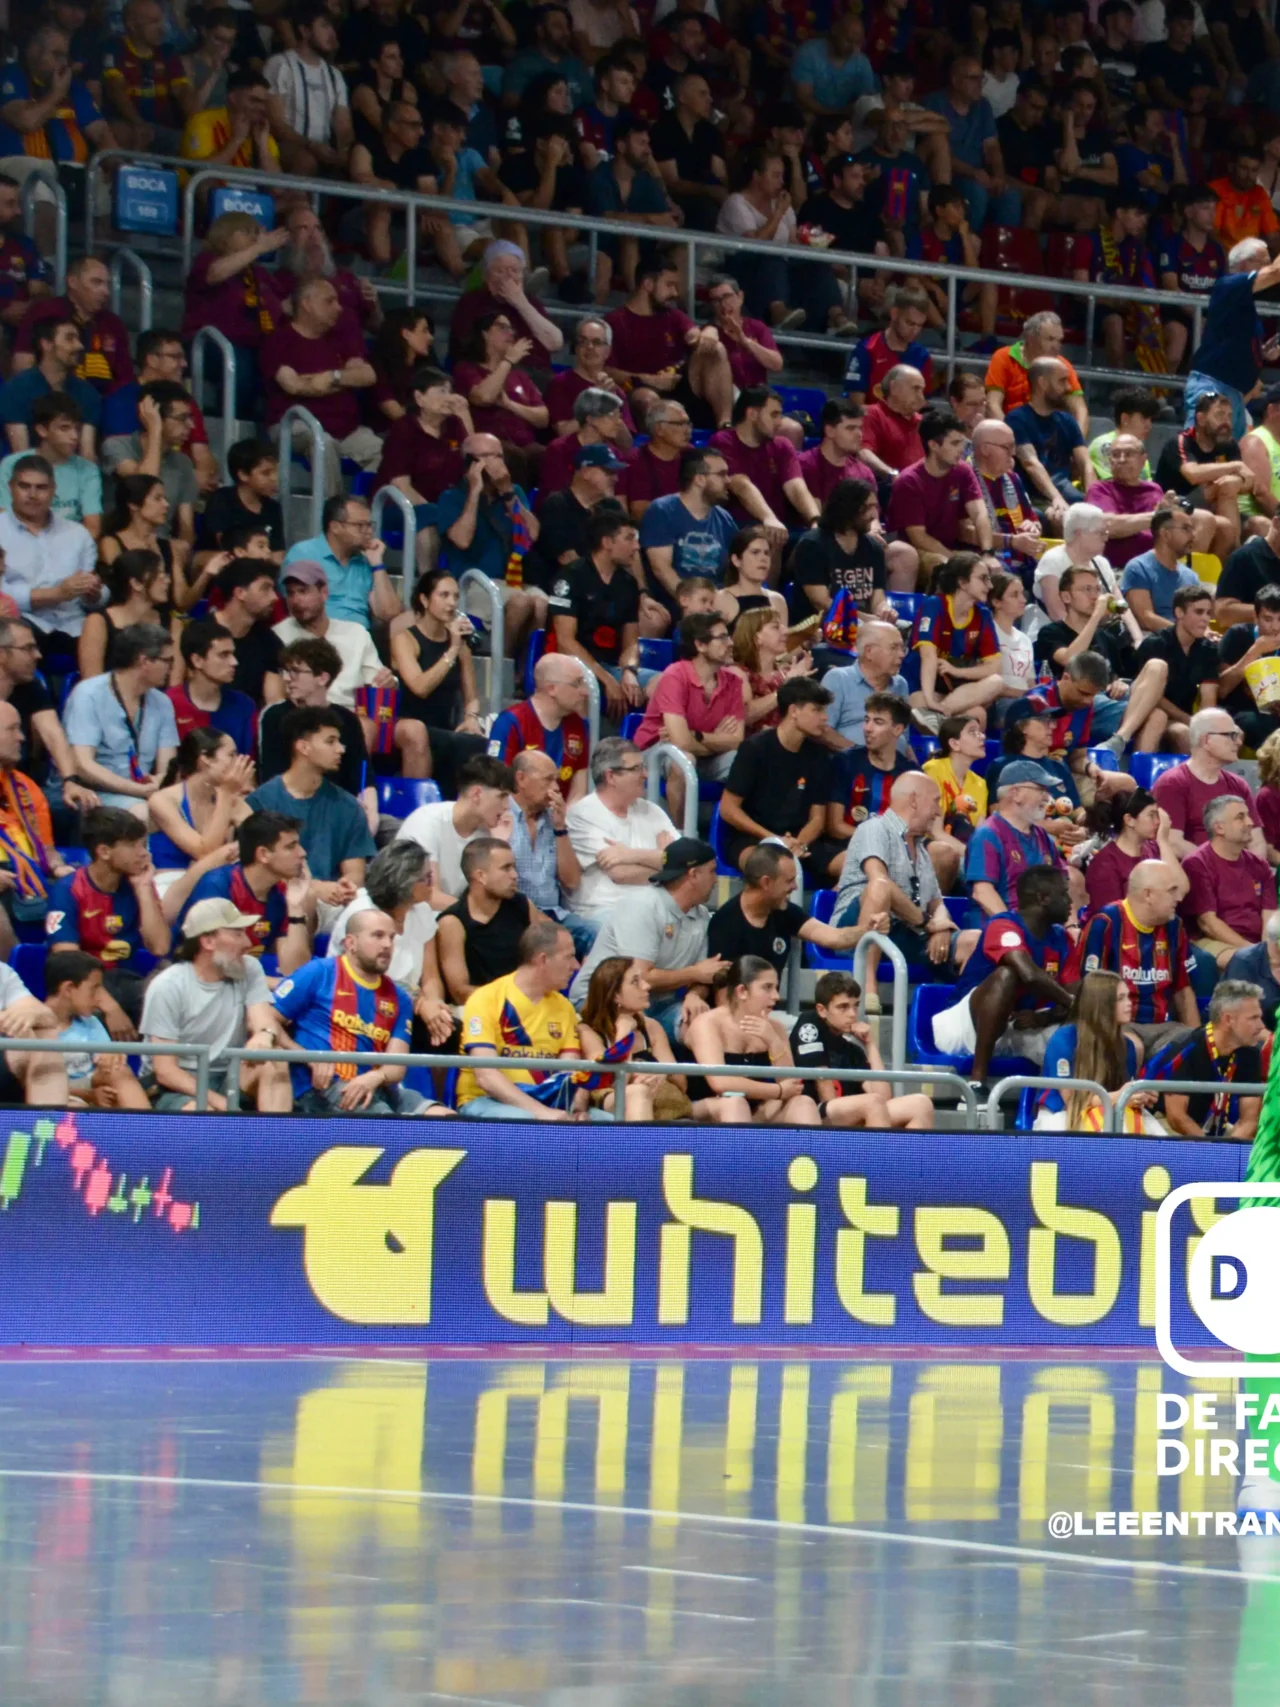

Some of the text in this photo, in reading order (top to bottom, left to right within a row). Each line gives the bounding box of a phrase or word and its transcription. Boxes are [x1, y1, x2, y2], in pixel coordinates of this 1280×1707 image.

[127, 175, 167, 194] BOCA
[223, 197, 263, 216] BOCA
[1122, 966, 1171, 982] Rakuten
[334, 1009, 392, 1044] Rakuten
